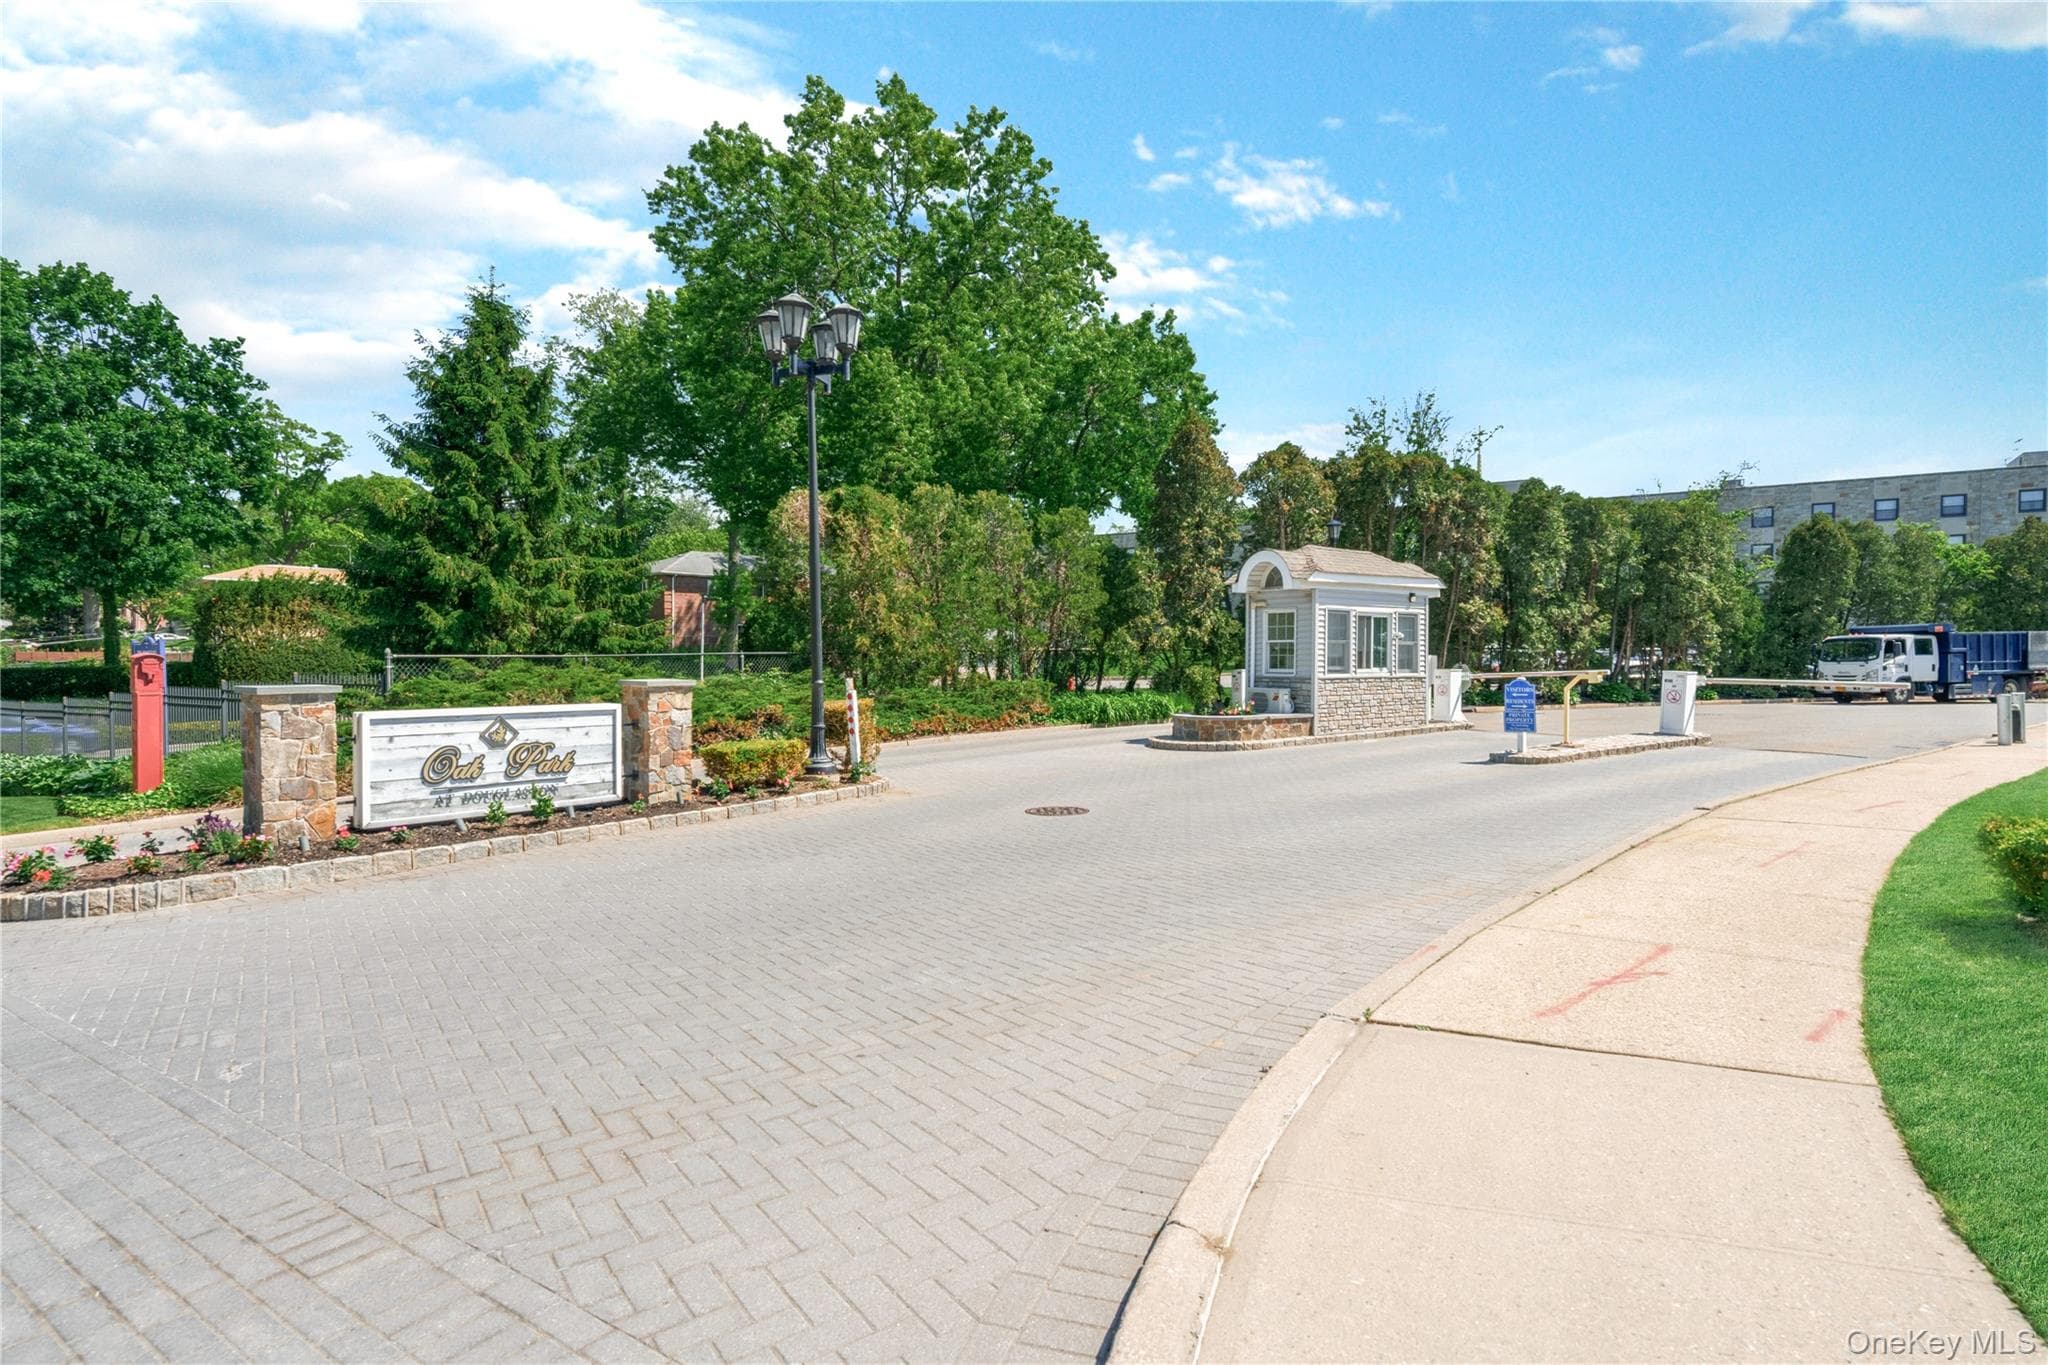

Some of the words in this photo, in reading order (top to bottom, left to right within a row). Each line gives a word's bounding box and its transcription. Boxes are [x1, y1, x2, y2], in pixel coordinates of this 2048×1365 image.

[422, 745, 486, 785] Oak
[504, 741, 577, 778] Park
[432, 794, 454, 808] AT
[461, 784, 559, 806] DOUGLASON
